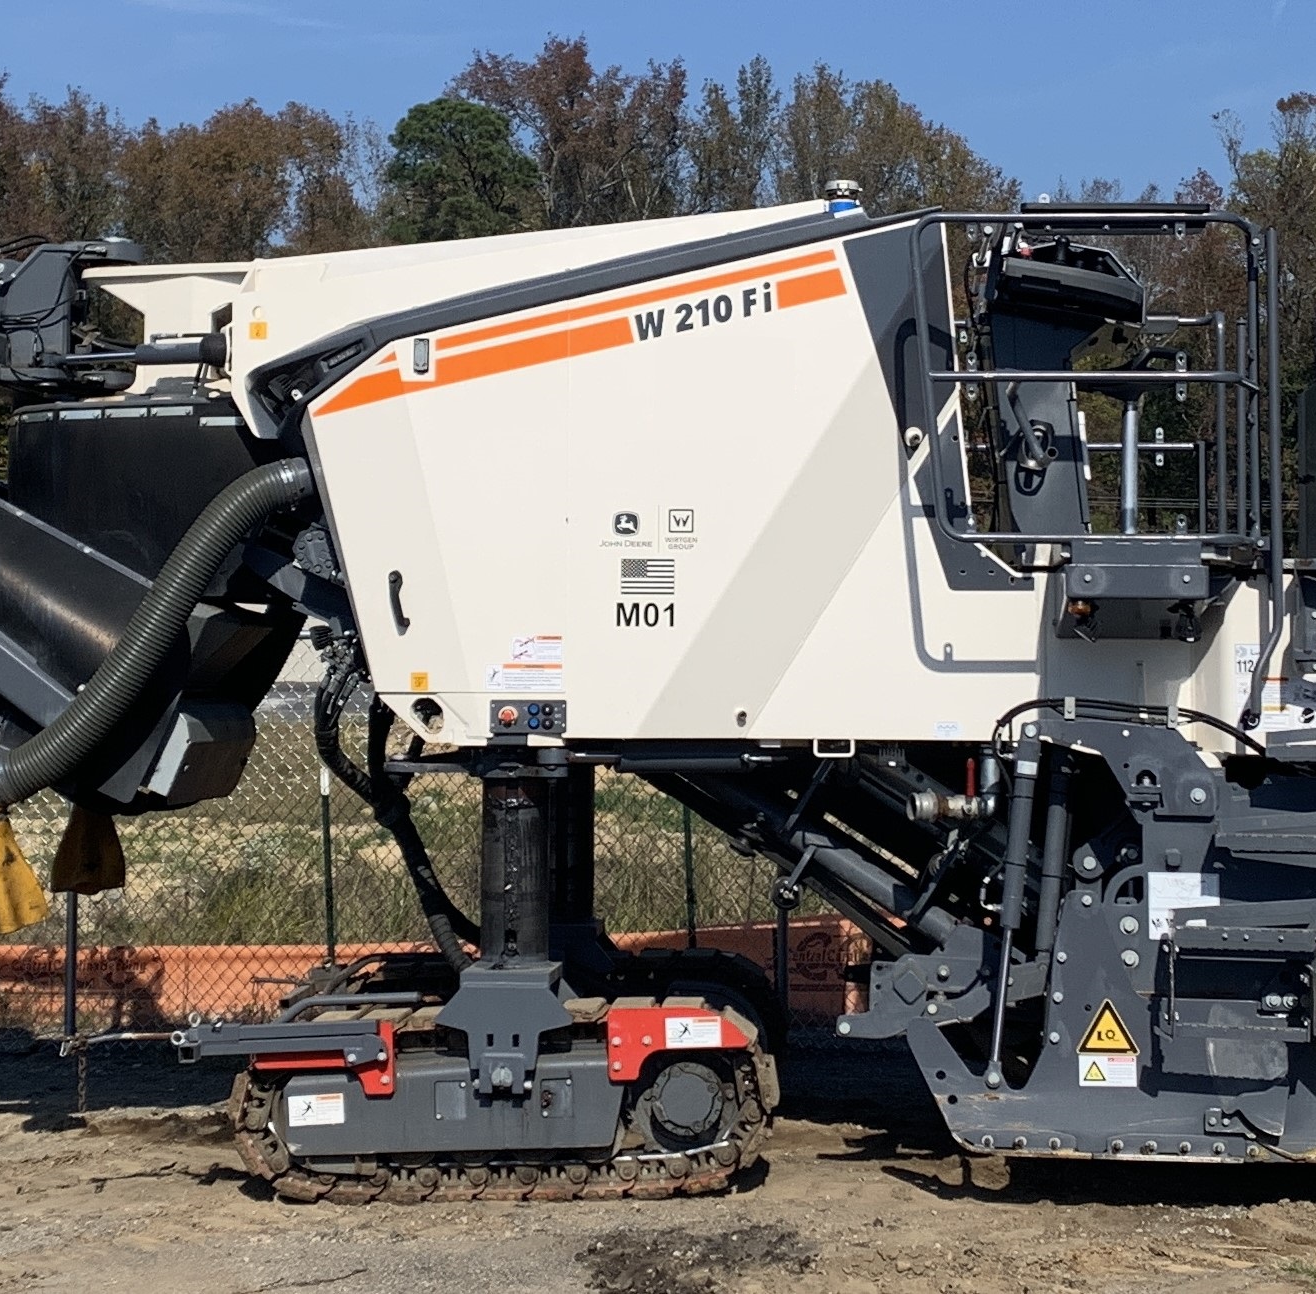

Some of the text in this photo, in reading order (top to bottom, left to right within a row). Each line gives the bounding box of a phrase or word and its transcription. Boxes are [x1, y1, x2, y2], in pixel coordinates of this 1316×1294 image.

[634, 308, 665, 341] W
[675, 294, 733, 333] 210
[599, 539, 653, 548] JOHN DEERE
[616, 602, 675, 627] M01
